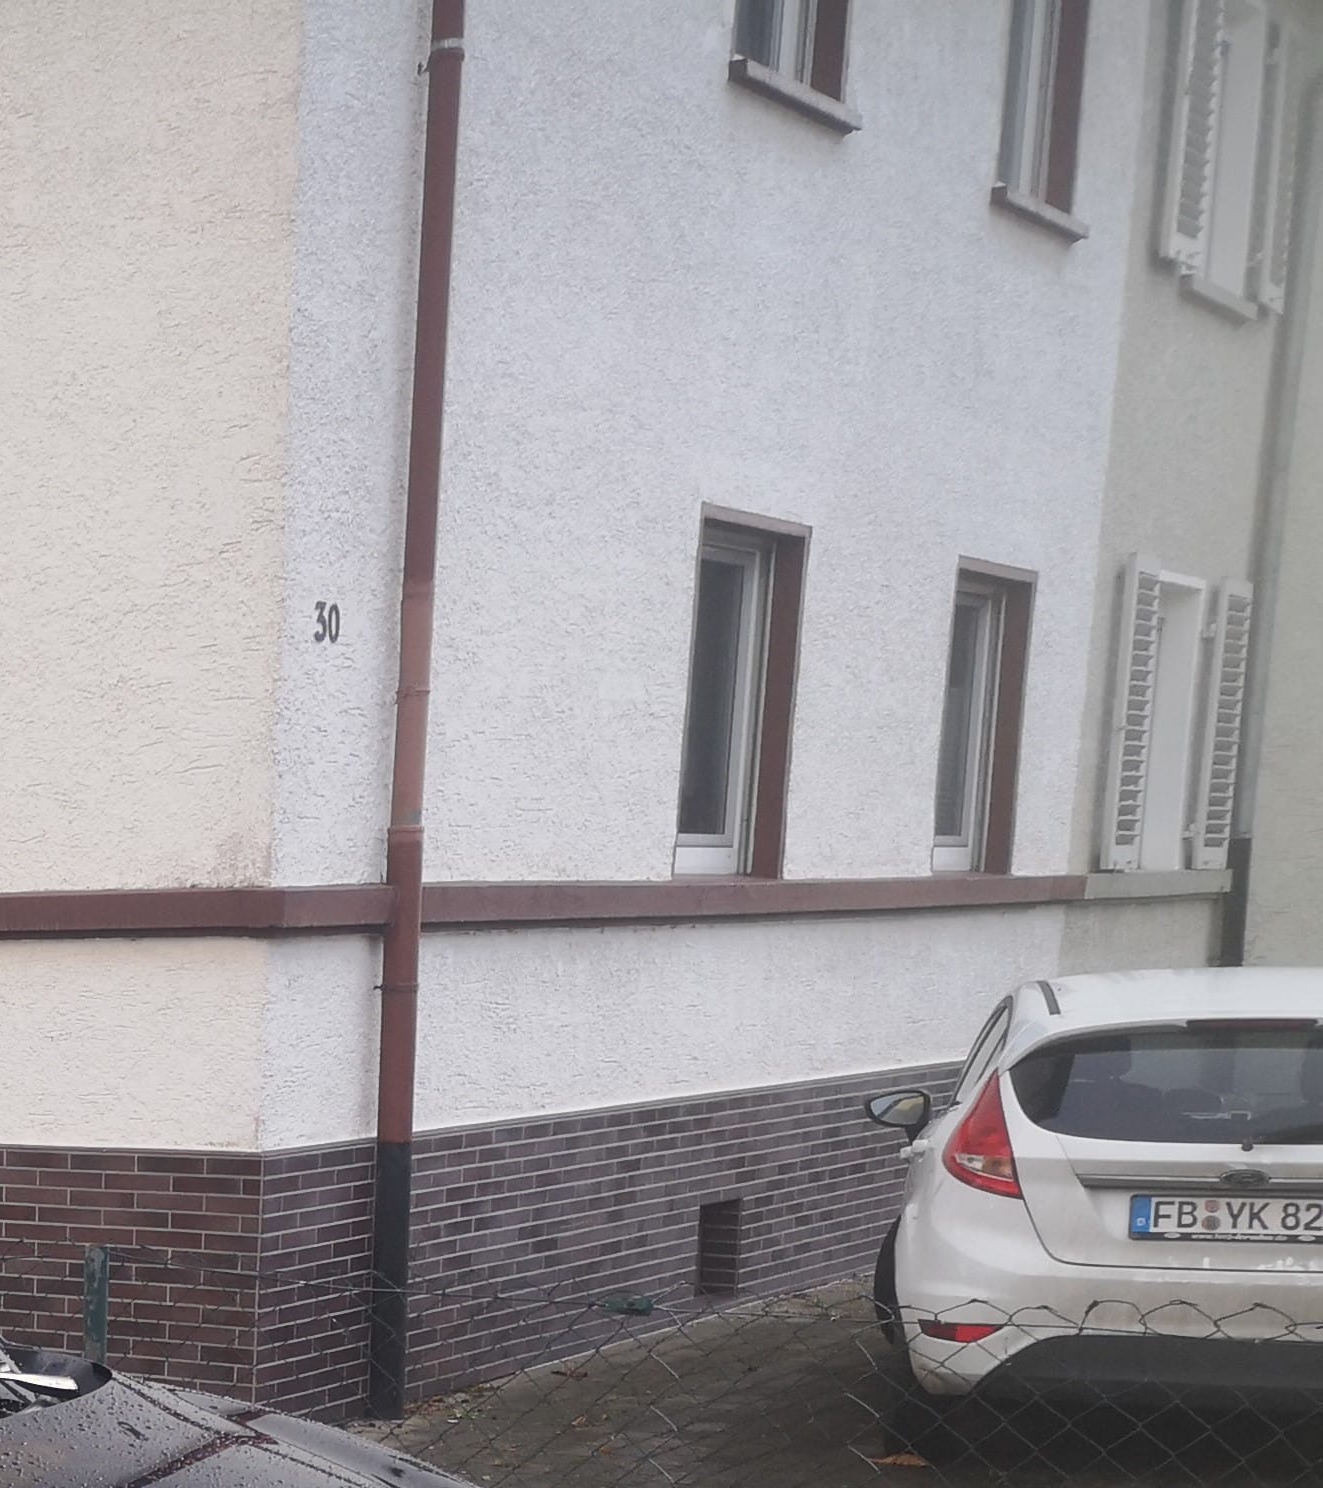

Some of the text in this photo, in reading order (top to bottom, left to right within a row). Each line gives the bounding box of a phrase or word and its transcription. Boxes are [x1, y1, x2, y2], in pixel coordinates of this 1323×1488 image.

[314, 600, 340, 643] 30
[1153, 1200, 1198, 1229] FB
[1225, 1202, 1271, 1230] YK
